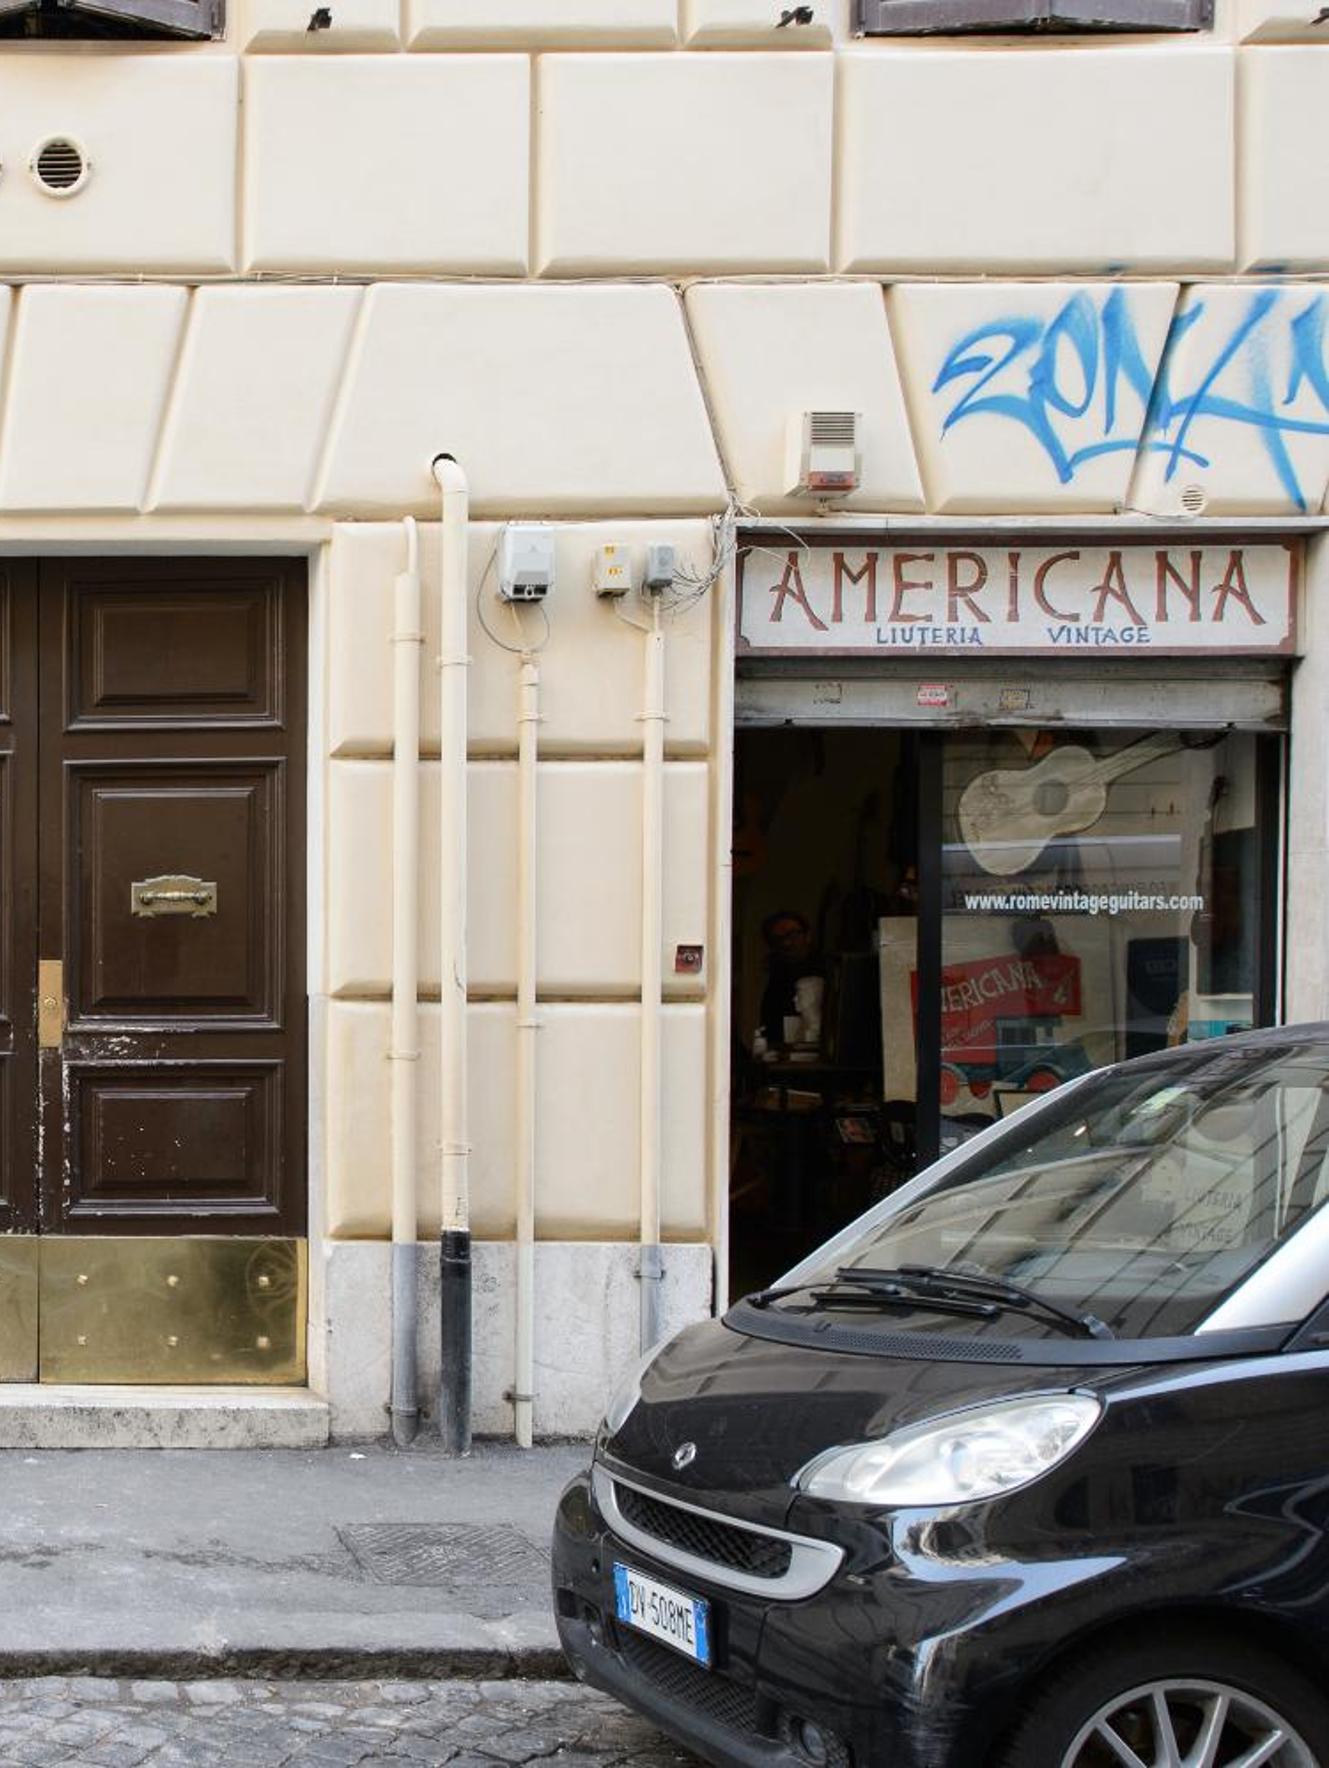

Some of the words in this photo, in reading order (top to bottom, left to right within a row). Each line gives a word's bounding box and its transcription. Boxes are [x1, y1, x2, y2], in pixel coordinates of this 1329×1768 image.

[769, 551, 1267, 631] AMERICANA
[876, 624, 983, 647] LIUTERIA
[1048, 624, 1152, 647] VINTAGE
[965, 891, 1204, 915] www.romevintageguitars.com
[941, 961, 1043, 1013] ERICANA
